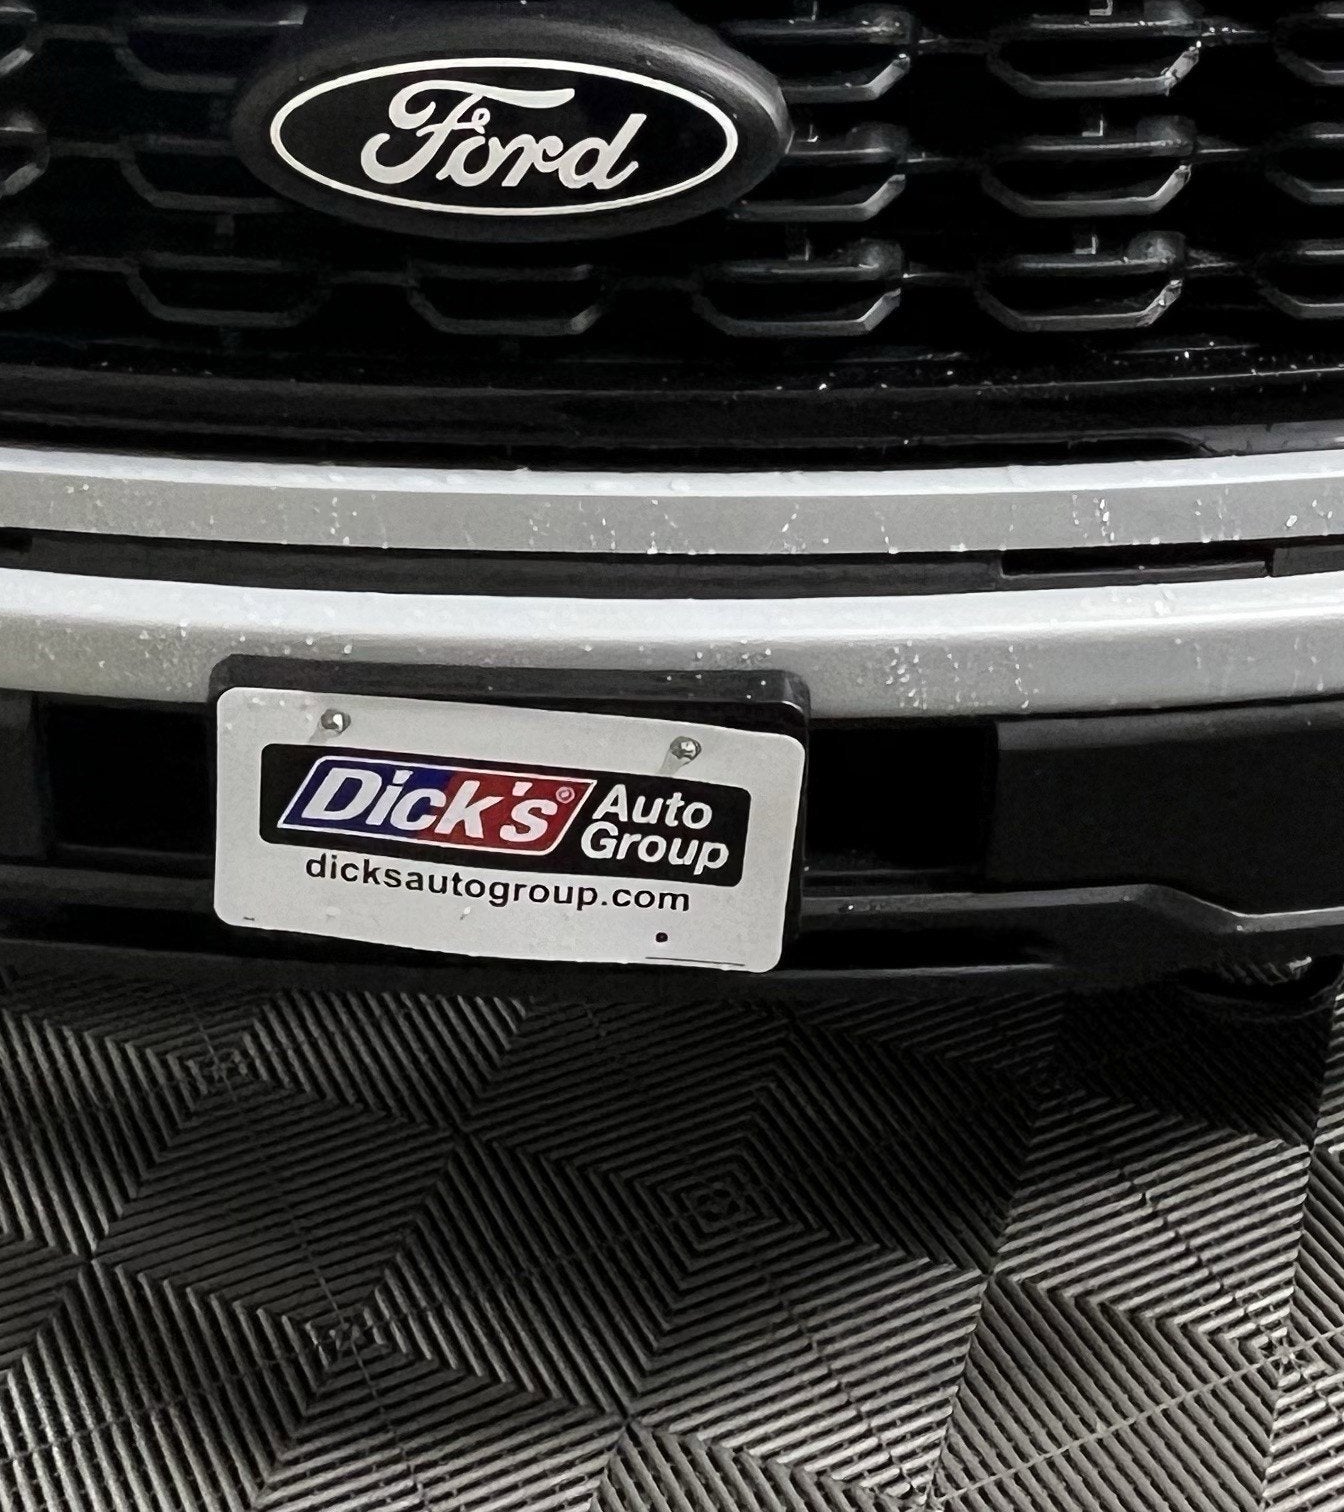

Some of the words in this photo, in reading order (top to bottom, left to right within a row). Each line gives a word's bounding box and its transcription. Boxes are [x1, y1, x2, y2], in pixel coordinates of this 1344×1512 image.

[360, 79, 648, 190] Ford
[593, 784, 714, 830] Auto
[581, 826, 730, 875] Group
[305, 853, 691, 912] dicksautogroup.com
